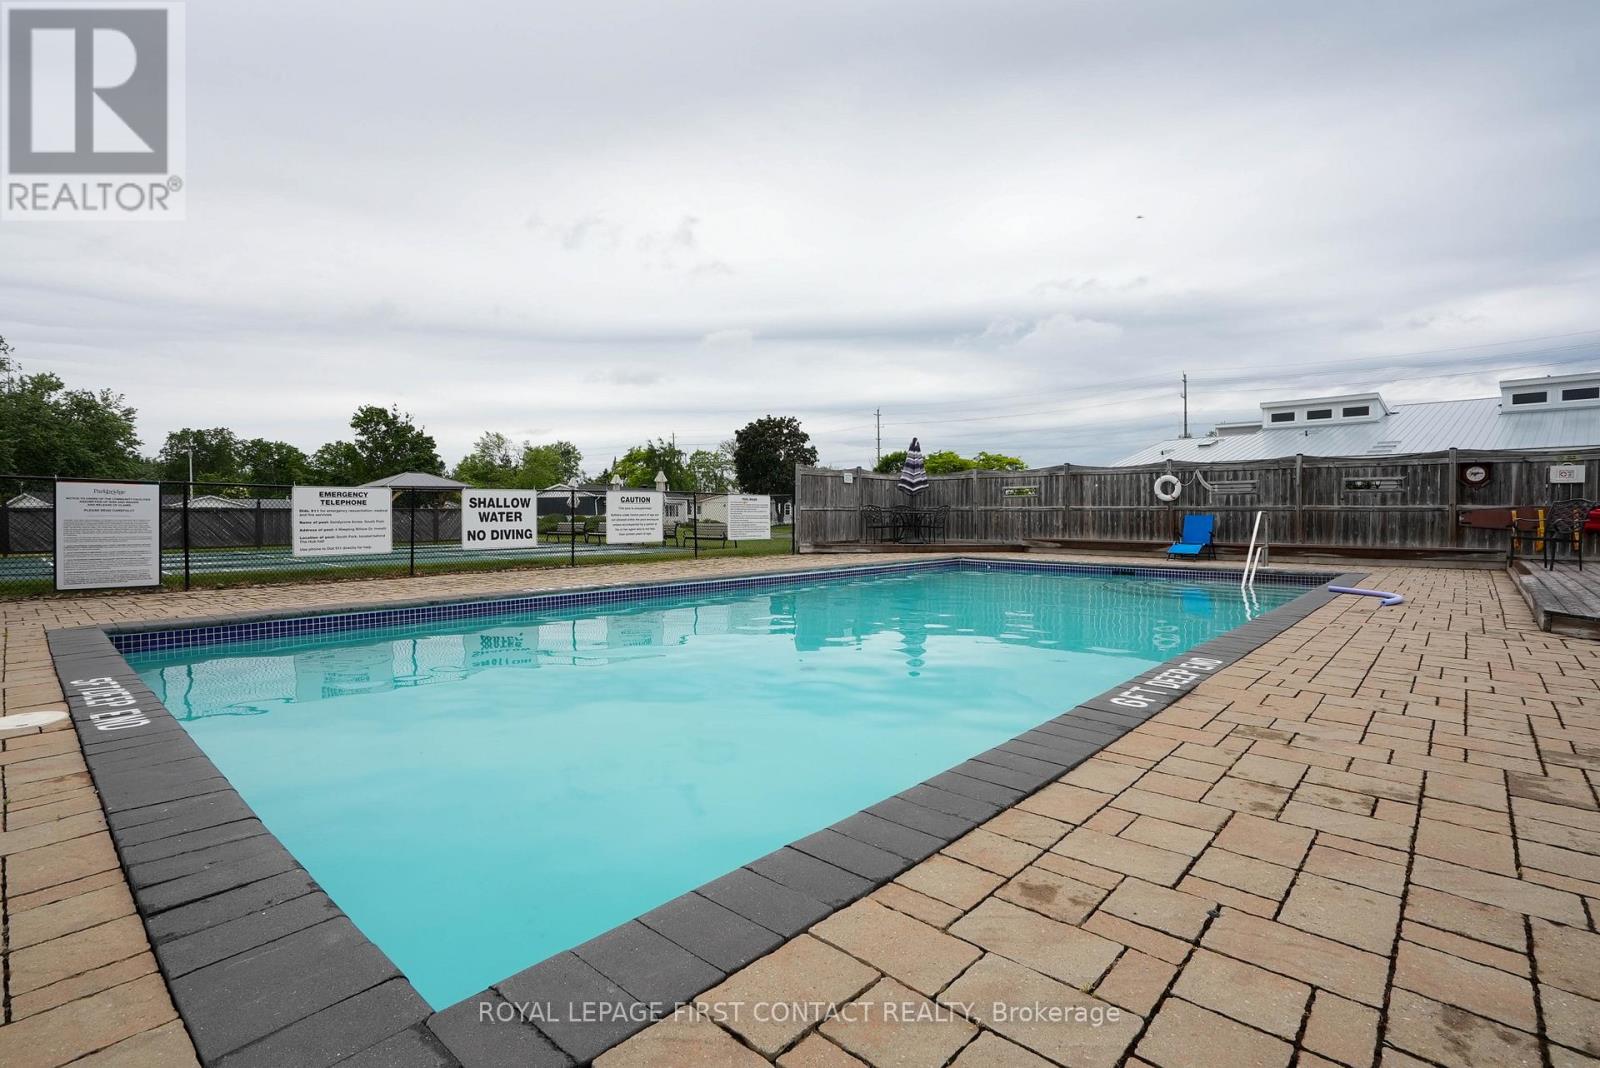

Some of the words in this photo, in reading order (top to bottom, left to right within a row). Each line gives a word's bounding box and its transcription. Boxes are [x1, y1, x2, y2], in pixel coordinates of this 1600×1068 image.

[469, 497, 532, 509] SHALLOW
[478, 511, 523, 523] WATER
[467, 530, 487, 541] NO
[491, 528, 533, 541] DIVING
[1110, 686, 1168, 708] 6FT
[1143, 669, 1201, 689] DEEP
[1179, 657, 1224, 671] END
[80, 687, 137, 707] DEEP
[89, 708, 151, 731] END
